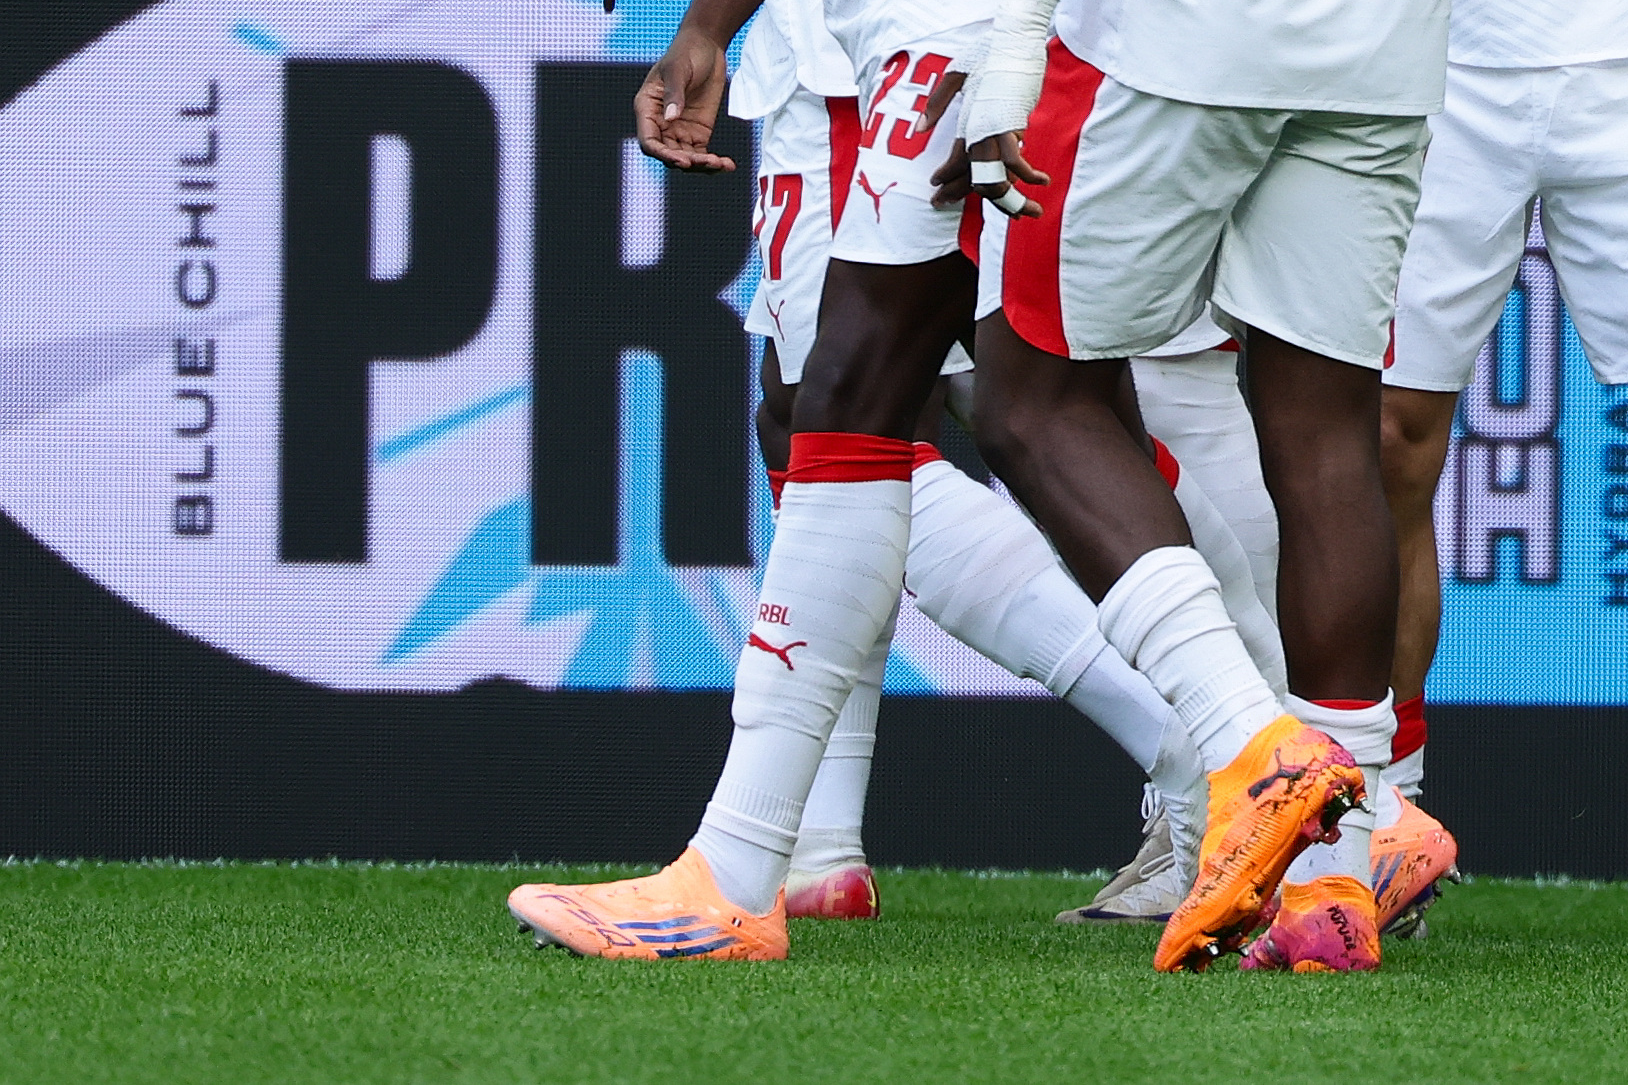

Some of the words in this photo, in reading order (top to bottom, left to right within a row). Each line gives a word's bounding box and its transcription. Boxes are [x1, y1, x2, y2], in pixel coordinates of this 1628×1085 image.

[858, 49, 955, 161] 23
[176, 79, 220, 310] CHILL
[172, 338, 216, 538] BLUE
[758, 603, 791, 626] RBL
